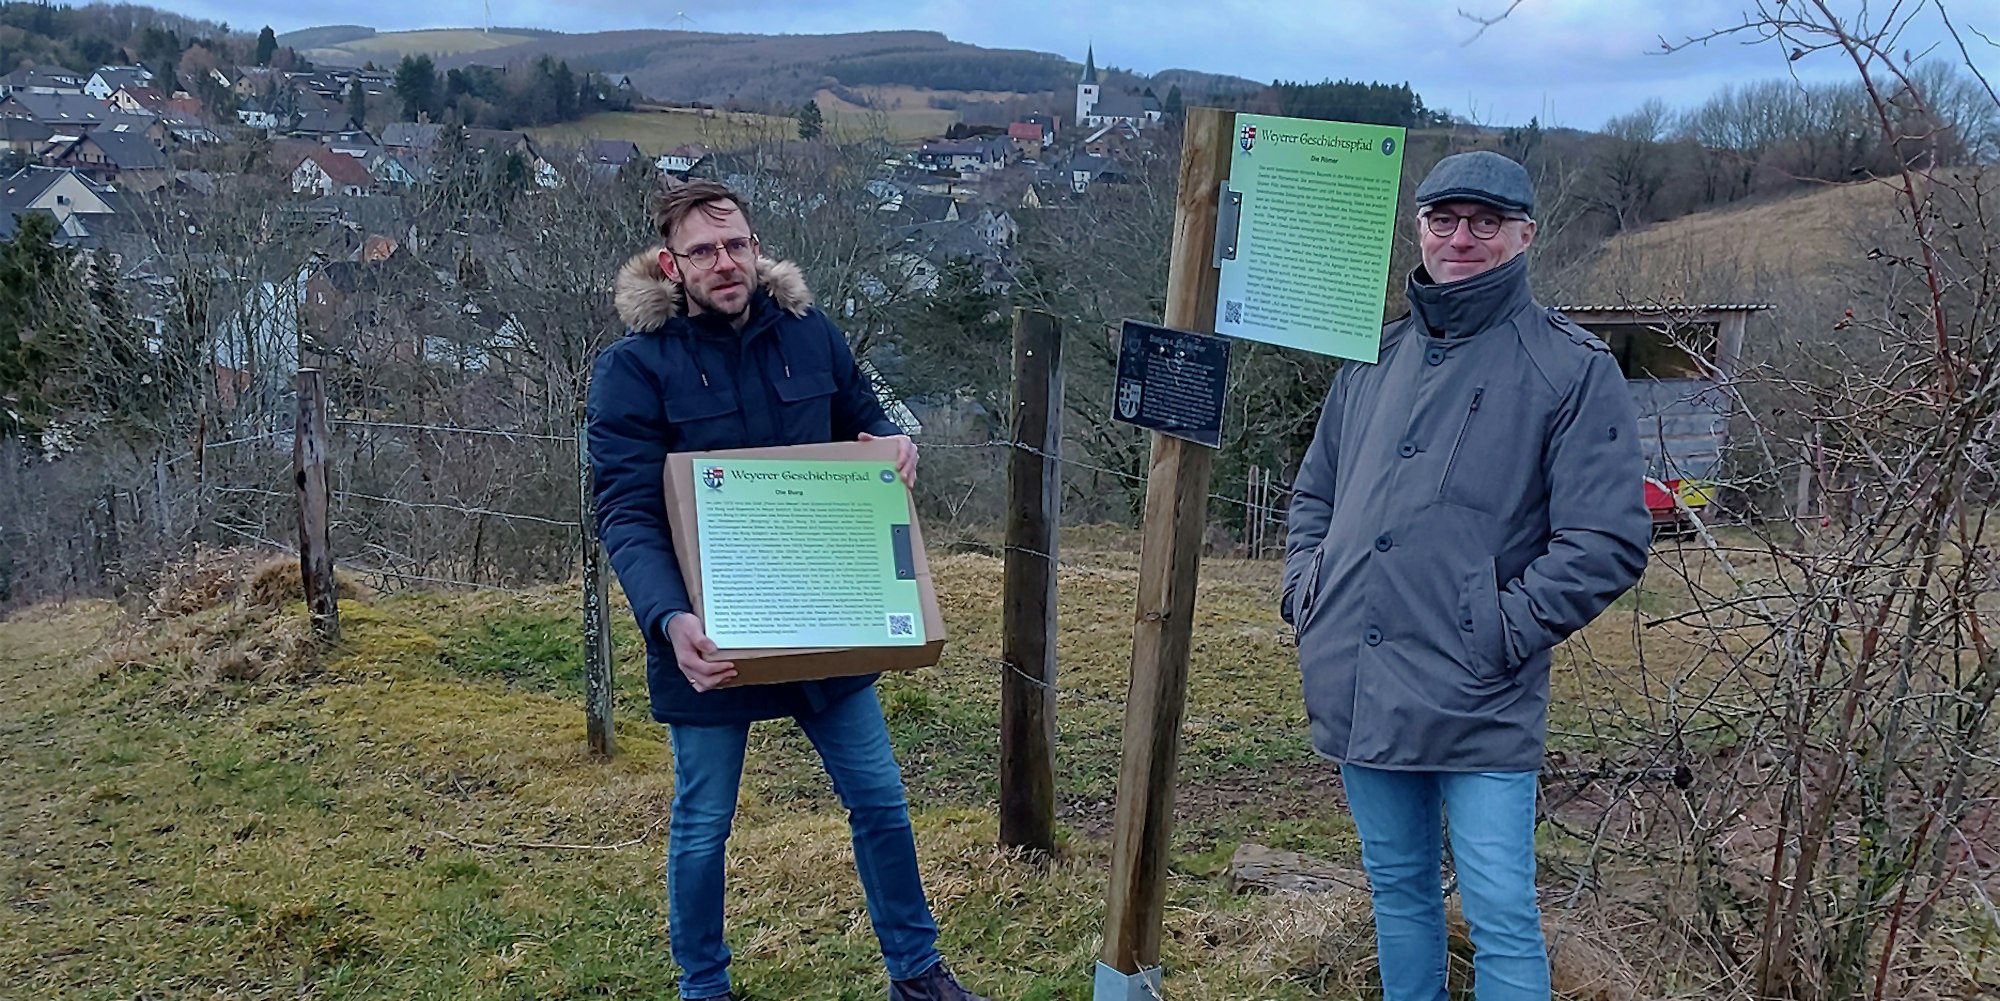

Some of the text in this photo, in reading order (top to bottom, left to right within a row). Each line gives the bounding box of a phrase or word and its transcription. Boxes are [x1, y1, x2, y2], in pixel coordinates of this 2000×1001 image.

[1262, 129, 1373, 152] Weyerer Geschichtspfad
[1321, 155, 1338, 164] Römer
[731, 470, 870, 484] Weyerer Geschichtspfad
[788, 489, 803, 497] Burg
